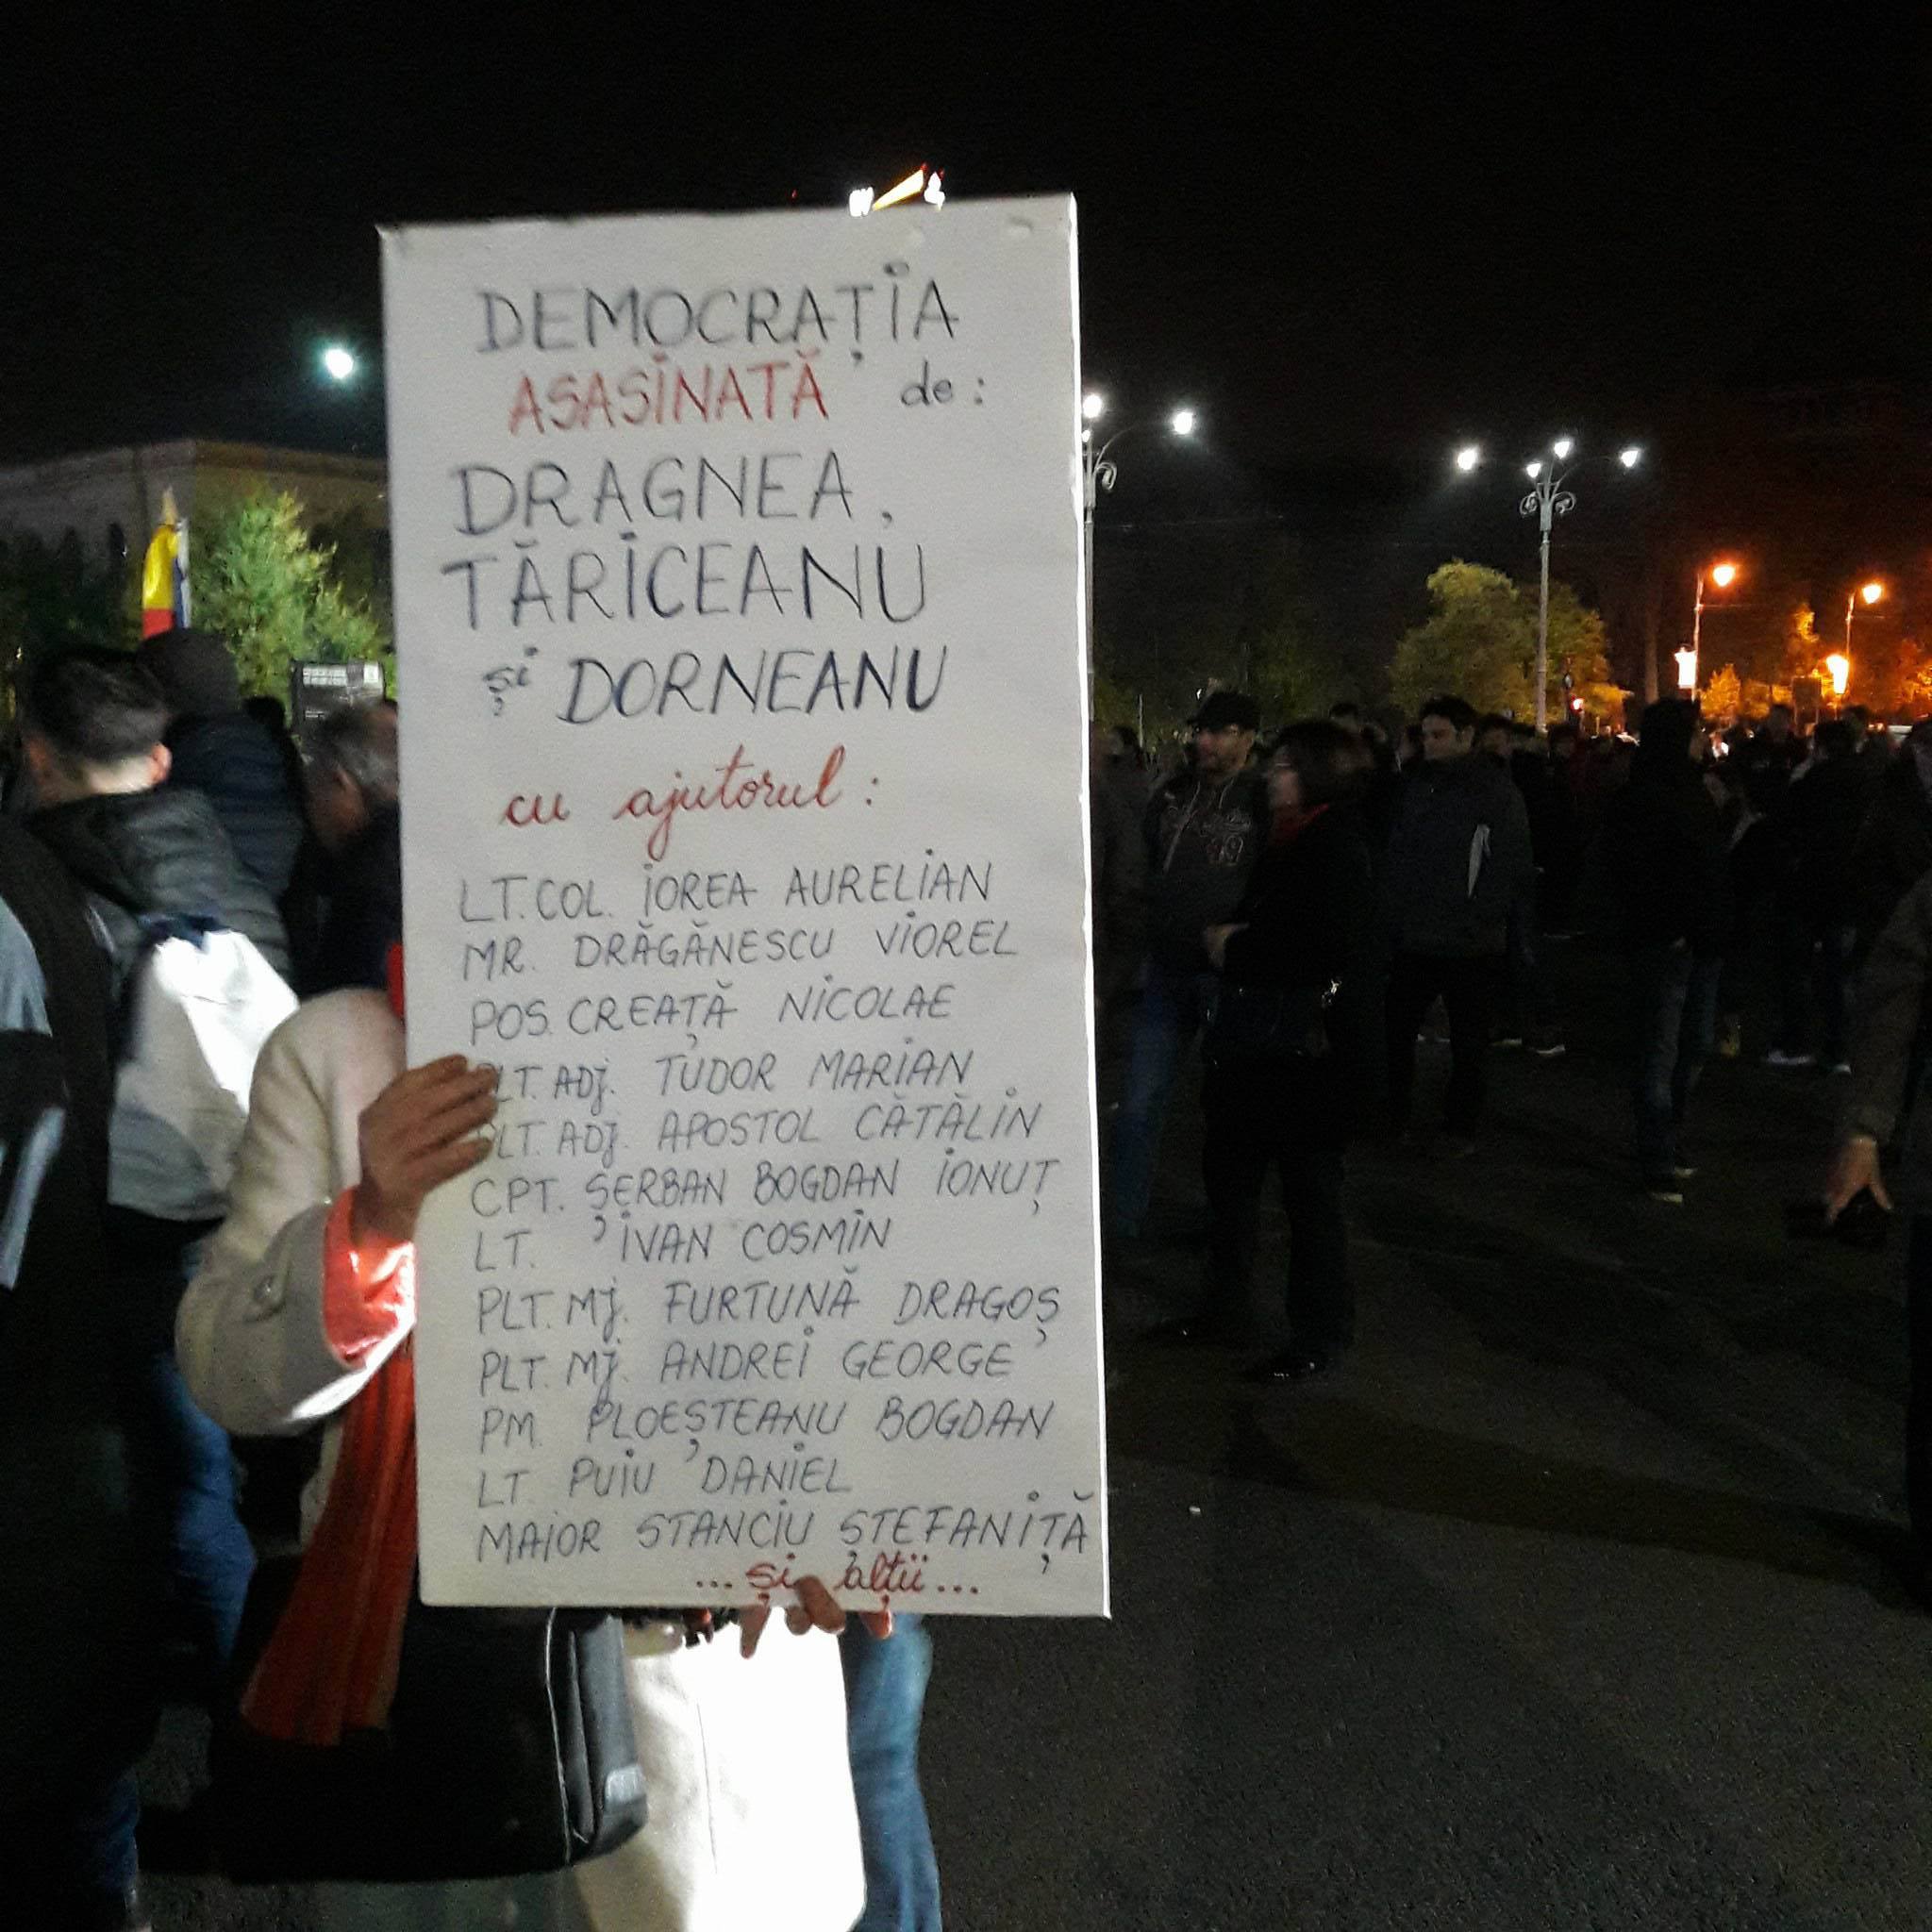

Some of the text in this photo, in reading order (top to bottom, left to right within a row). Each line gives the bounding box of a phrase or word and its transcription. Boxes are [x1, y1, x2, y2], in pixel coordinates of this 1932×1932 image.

[448, 450, 894, 535] DRAGNEA,
[557, 645, 948, 724] DORNEANU
[498, 790, 571, 827] cu
[462, 937, 537, 981] MR.
[574, 919, 835, 970] DRĂGĂNESCU
[656, 1050, 775, 1097] TUDOR
[658, 1108, 820, 1153] APOSTOL
[471, 1177, 564, 1218] CPT.
[755, 1158, 900, 1204] BOGDAN
[474, 1231, 536, 1272] LT.
[478, 1287, 553, 1335] PLT.
[665, 1266, 861, 1323] FURTUNĂ
[481, 1351, 548, 1397] PLT.
[842, 1341, 1014, 1381] GEORGE
[875, 1397, 1056, 1441] BOGDAN
[478, 1470, 531, 1509] LT
